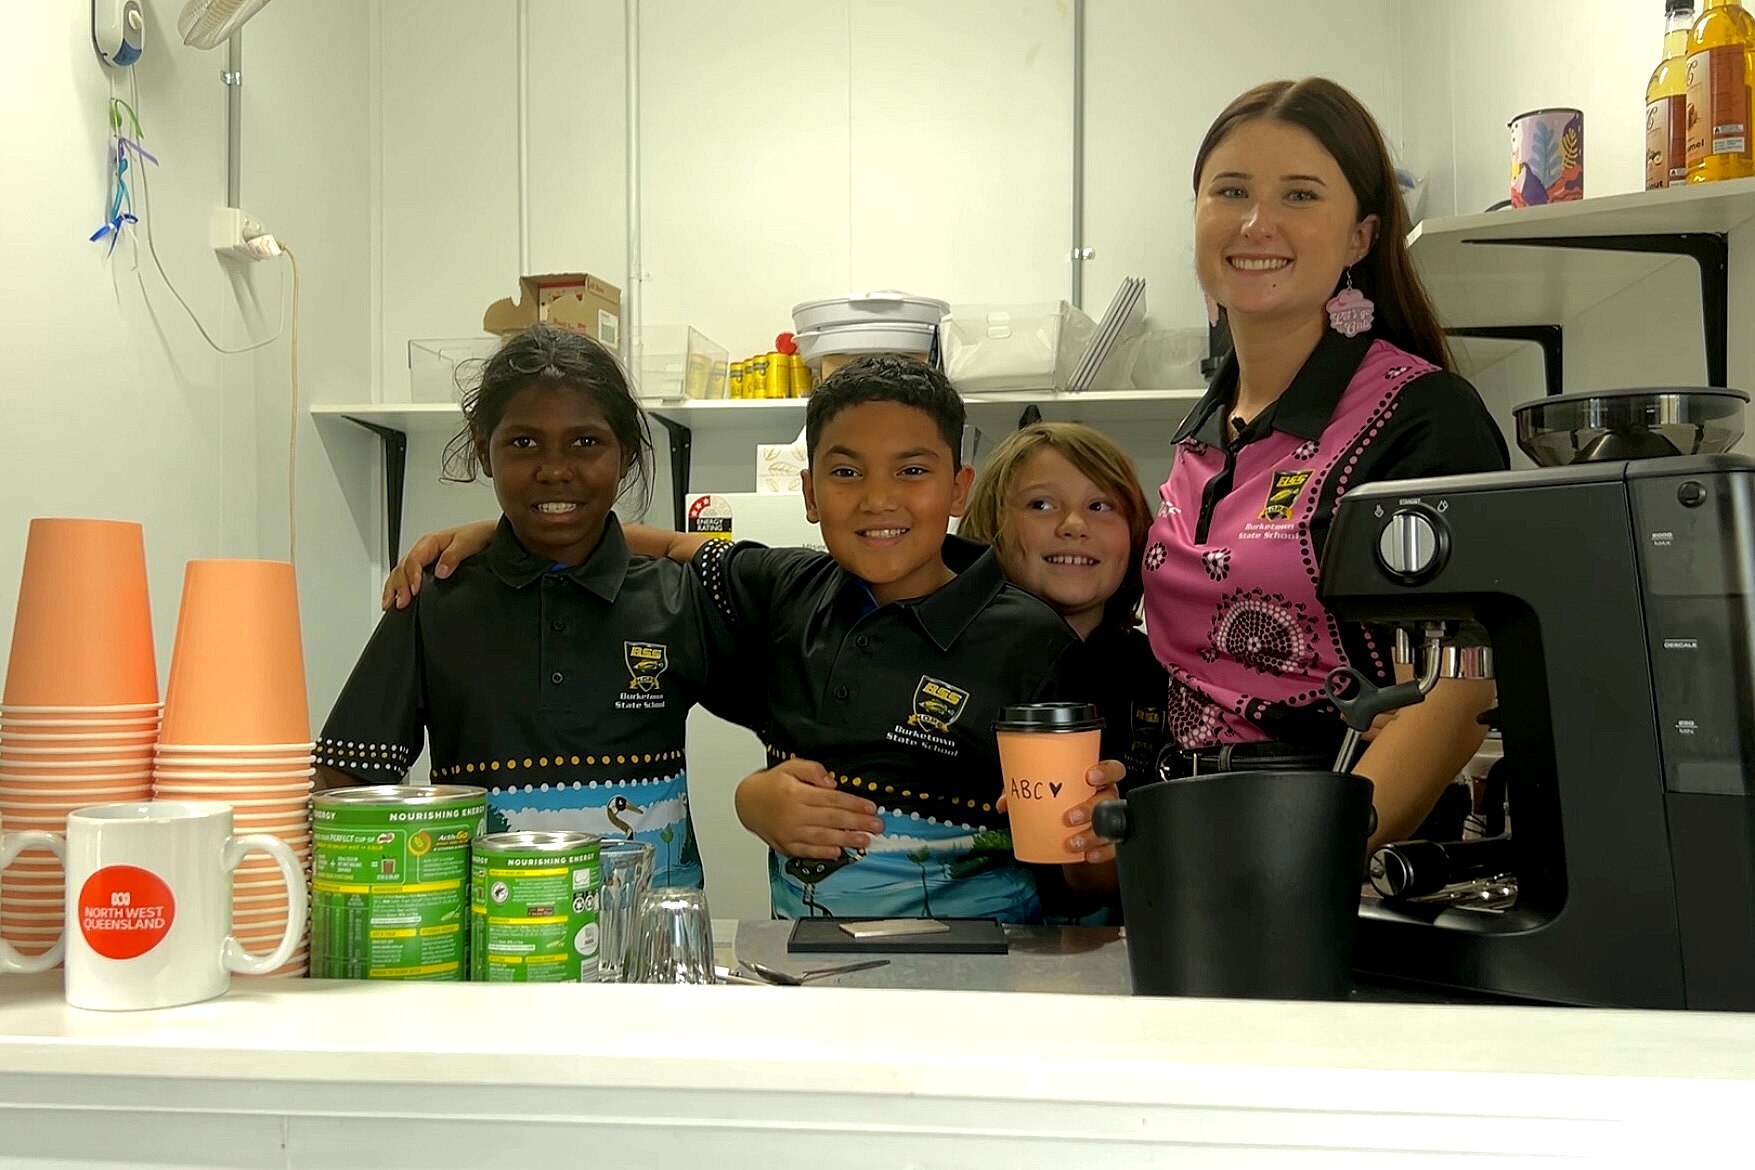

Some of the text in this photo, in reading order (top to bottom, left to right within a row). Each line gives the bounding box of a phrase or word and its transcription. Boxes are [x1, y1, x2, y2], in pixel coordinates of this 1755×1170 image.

[1264, 531, 1299, 540] School
[620, 692, 663, 700] Burketown
[615, 701, 641, 709] State
[894, 725, 956, 747] Burketown
[886, 732, 958, 756] State School
[1011, 778, 1043, 799] ABC
[389, 805, 485, 821] NOURISHING ENERGY
[508, 853, 595, 866] NOURISHING ENERGY
[85, 906, 164, 918] NORTH WEST
[83, 918, 165, 931] QUEENSLAND
